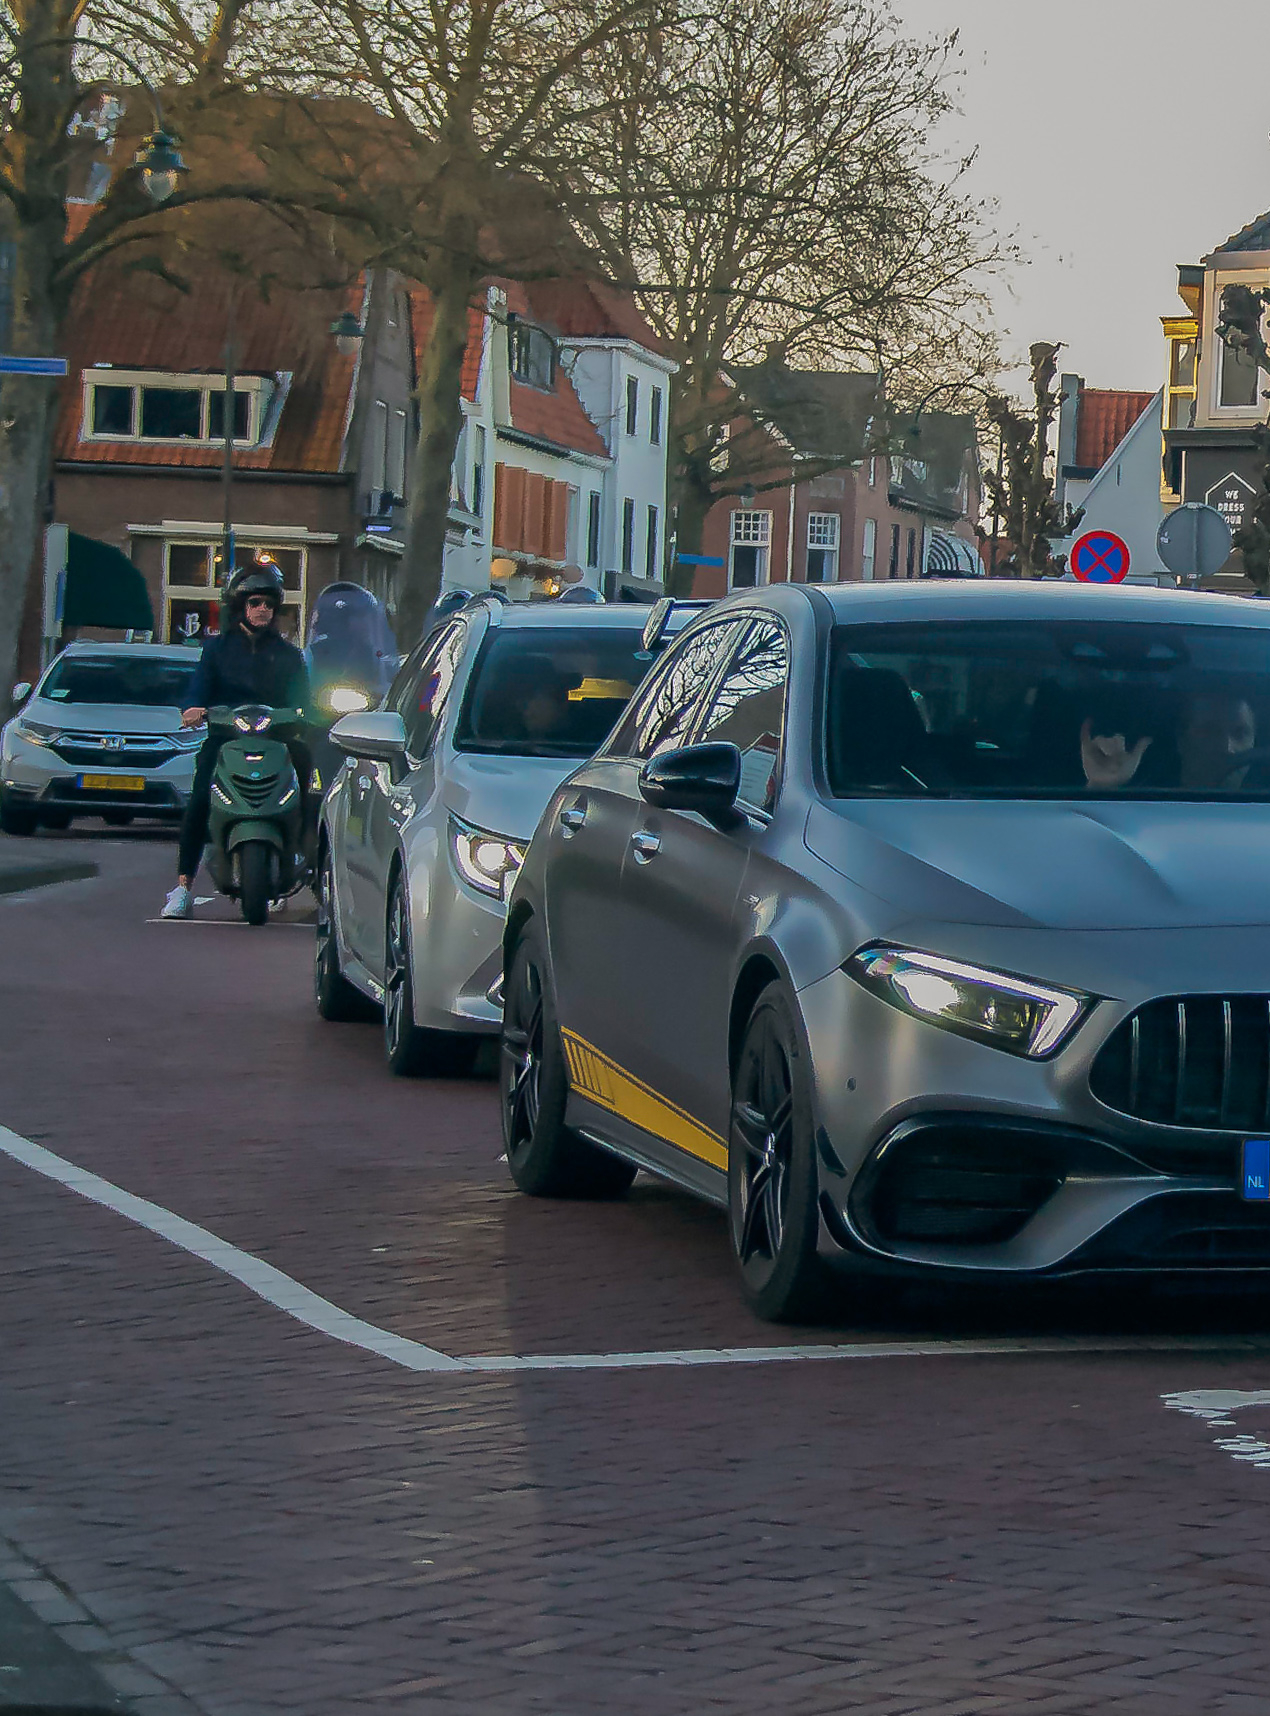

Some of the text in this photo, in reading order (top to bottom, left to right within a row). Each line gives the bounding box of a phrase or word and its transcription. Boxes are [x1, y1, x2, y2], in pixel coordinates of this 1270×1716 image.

[1224, 489, 1240, 500] WE
[1217, 502, 1245, 512] DRESS
[1247, 1174, 1265, 1189] NL
